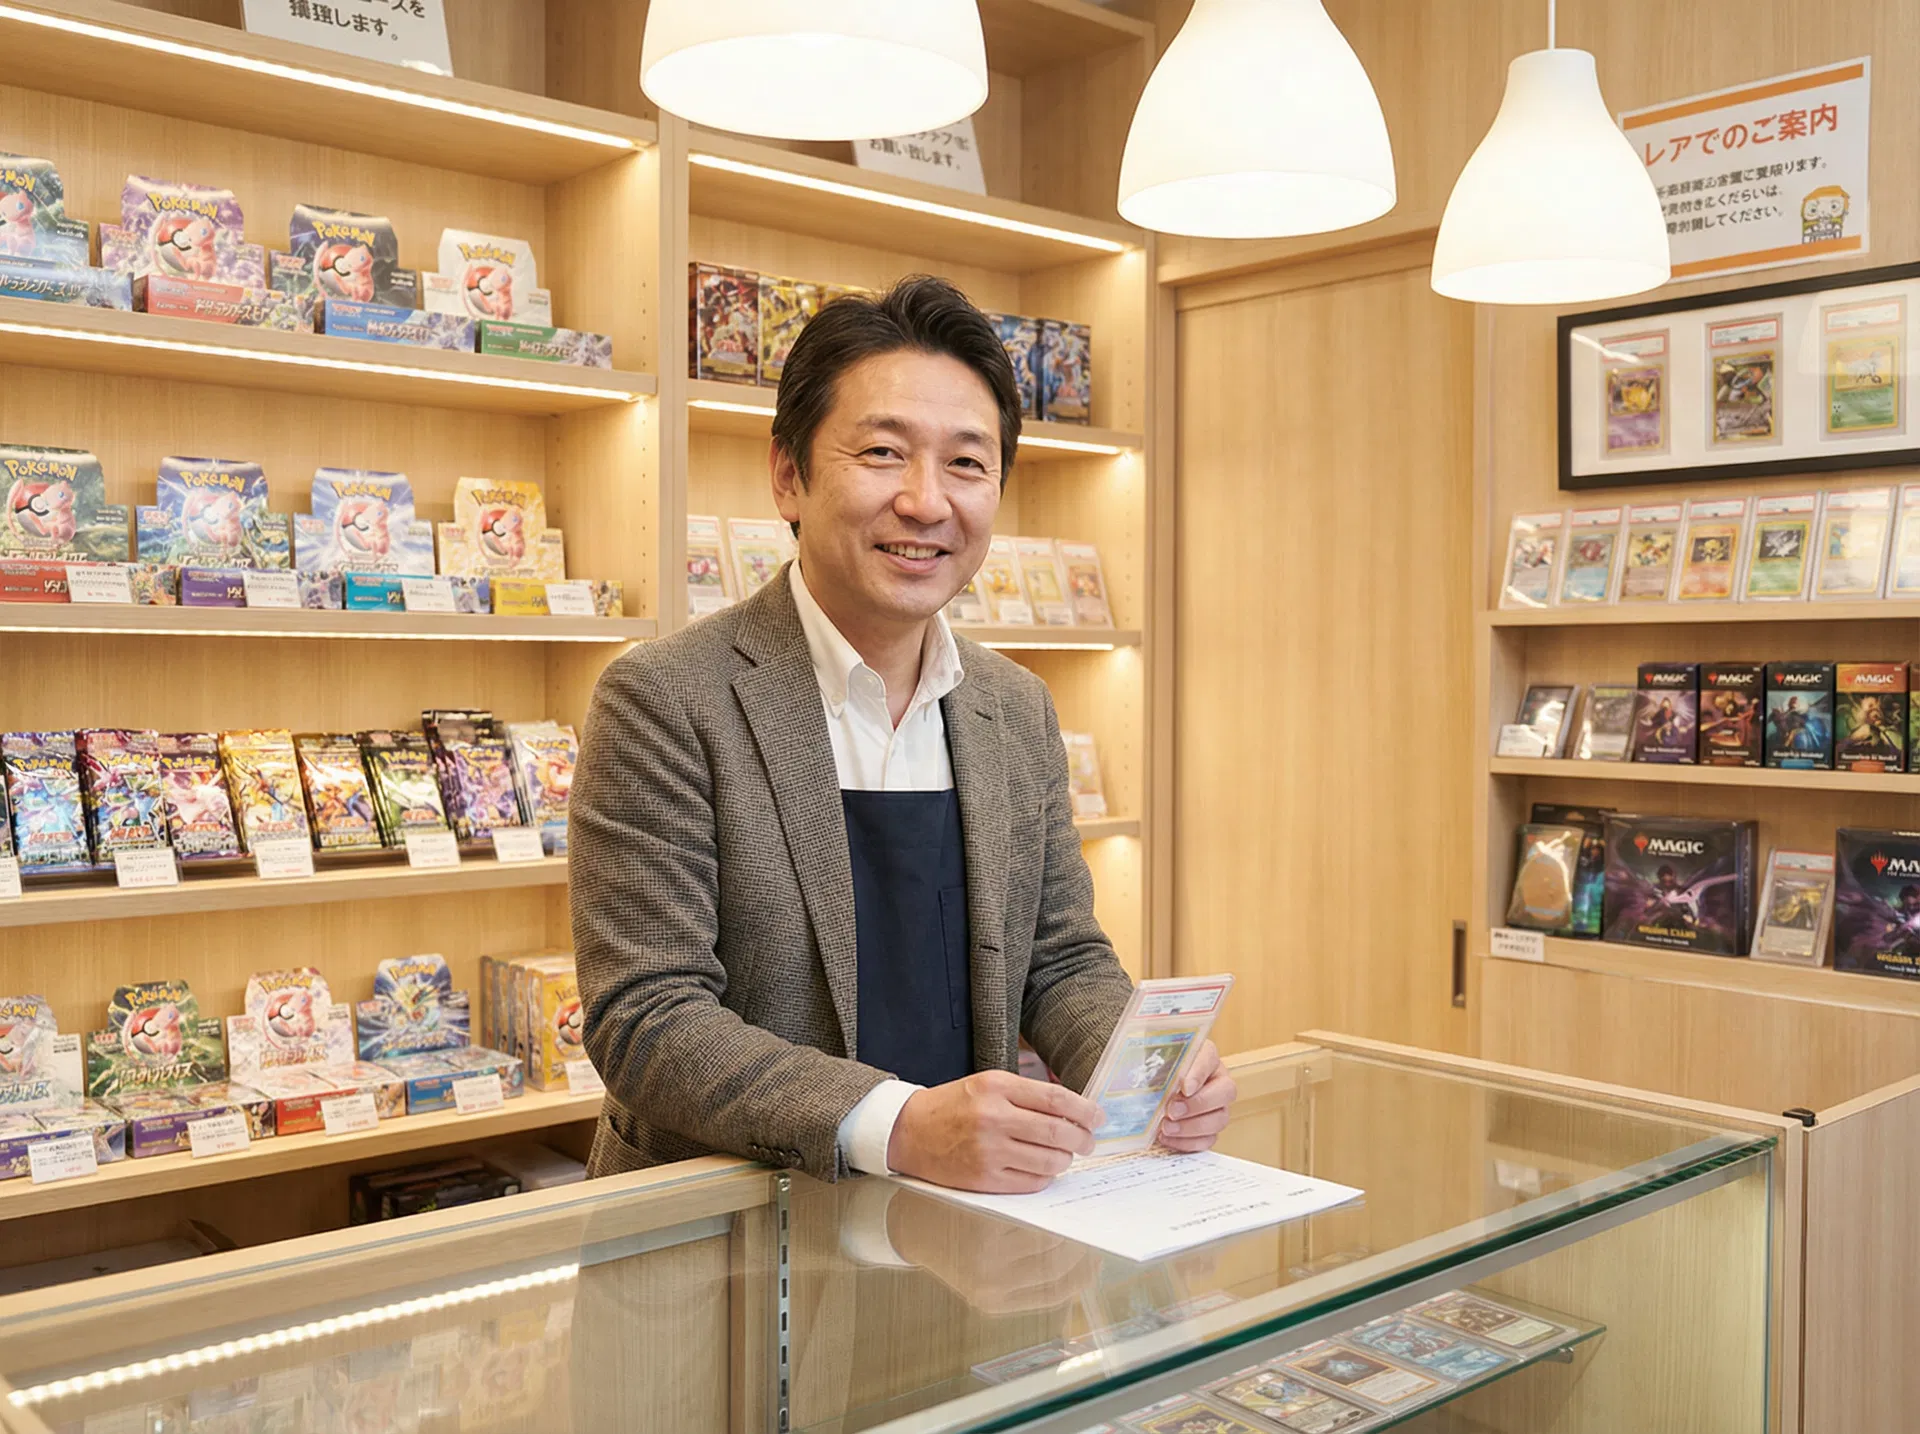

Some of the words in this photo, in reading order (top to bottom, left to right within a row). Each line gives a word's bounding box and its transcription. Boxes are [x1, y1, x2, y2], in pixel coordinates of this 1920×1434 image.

[1645, 103, 1838, 167] レアでのご案内
[1653, 673, 1687, 683] MAGIC
[1717, 674, 1754, 684] MAGIC
[1783, 674, 1822, 684] MAGIC
[1855, 674, 1894, 684] MAGIC
[1647, 838, 1704, 854] MAGIC
